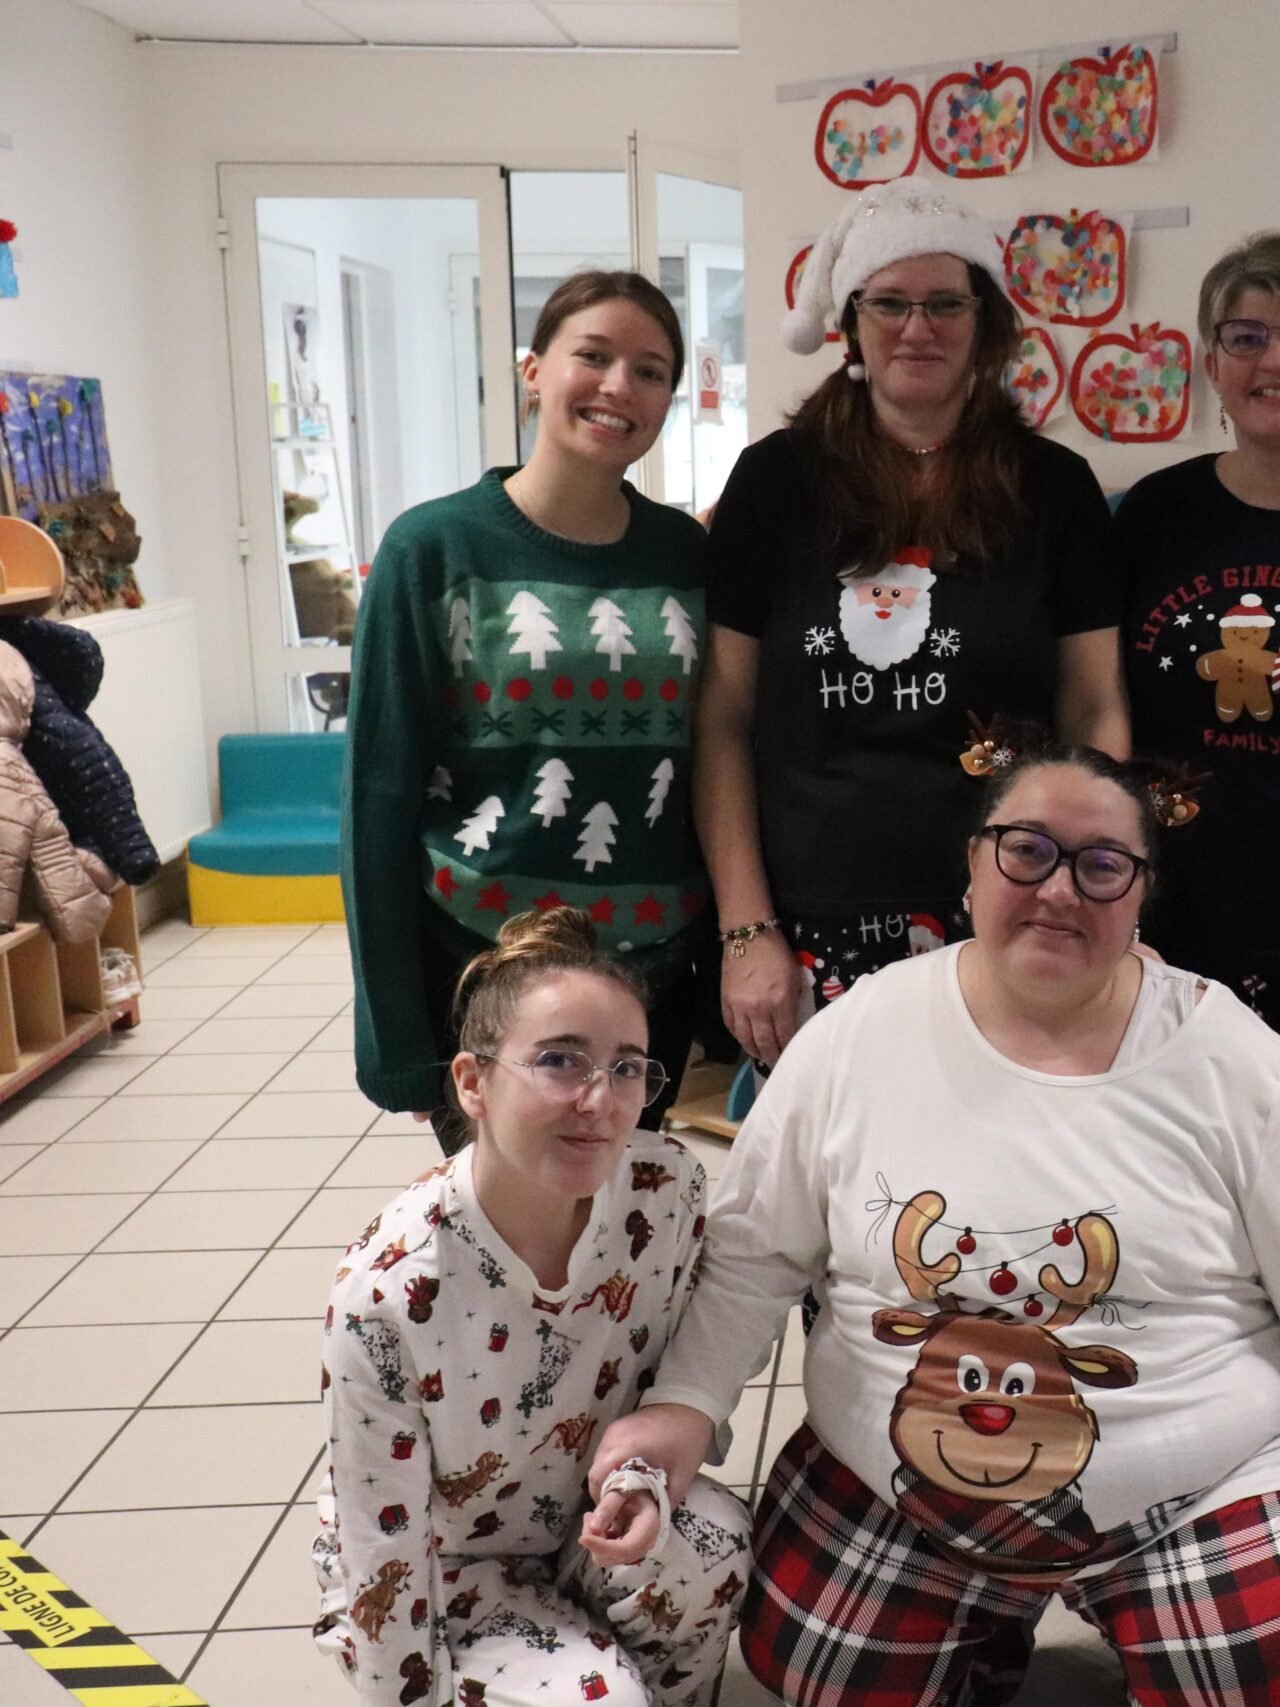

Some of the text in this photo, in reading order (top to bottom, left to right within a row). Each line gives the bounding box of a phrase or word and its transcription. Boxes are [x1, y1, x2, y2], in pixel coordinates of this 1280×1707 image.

[1136, 575, 1213, 652] LITTLE
[819, 668, 946, 711] HO HO
[1203, 729, 1280, 755] FAMILY
[4, 1584, 38, 1605] DE
[21, 1600, 76, 1639] LIGNE
